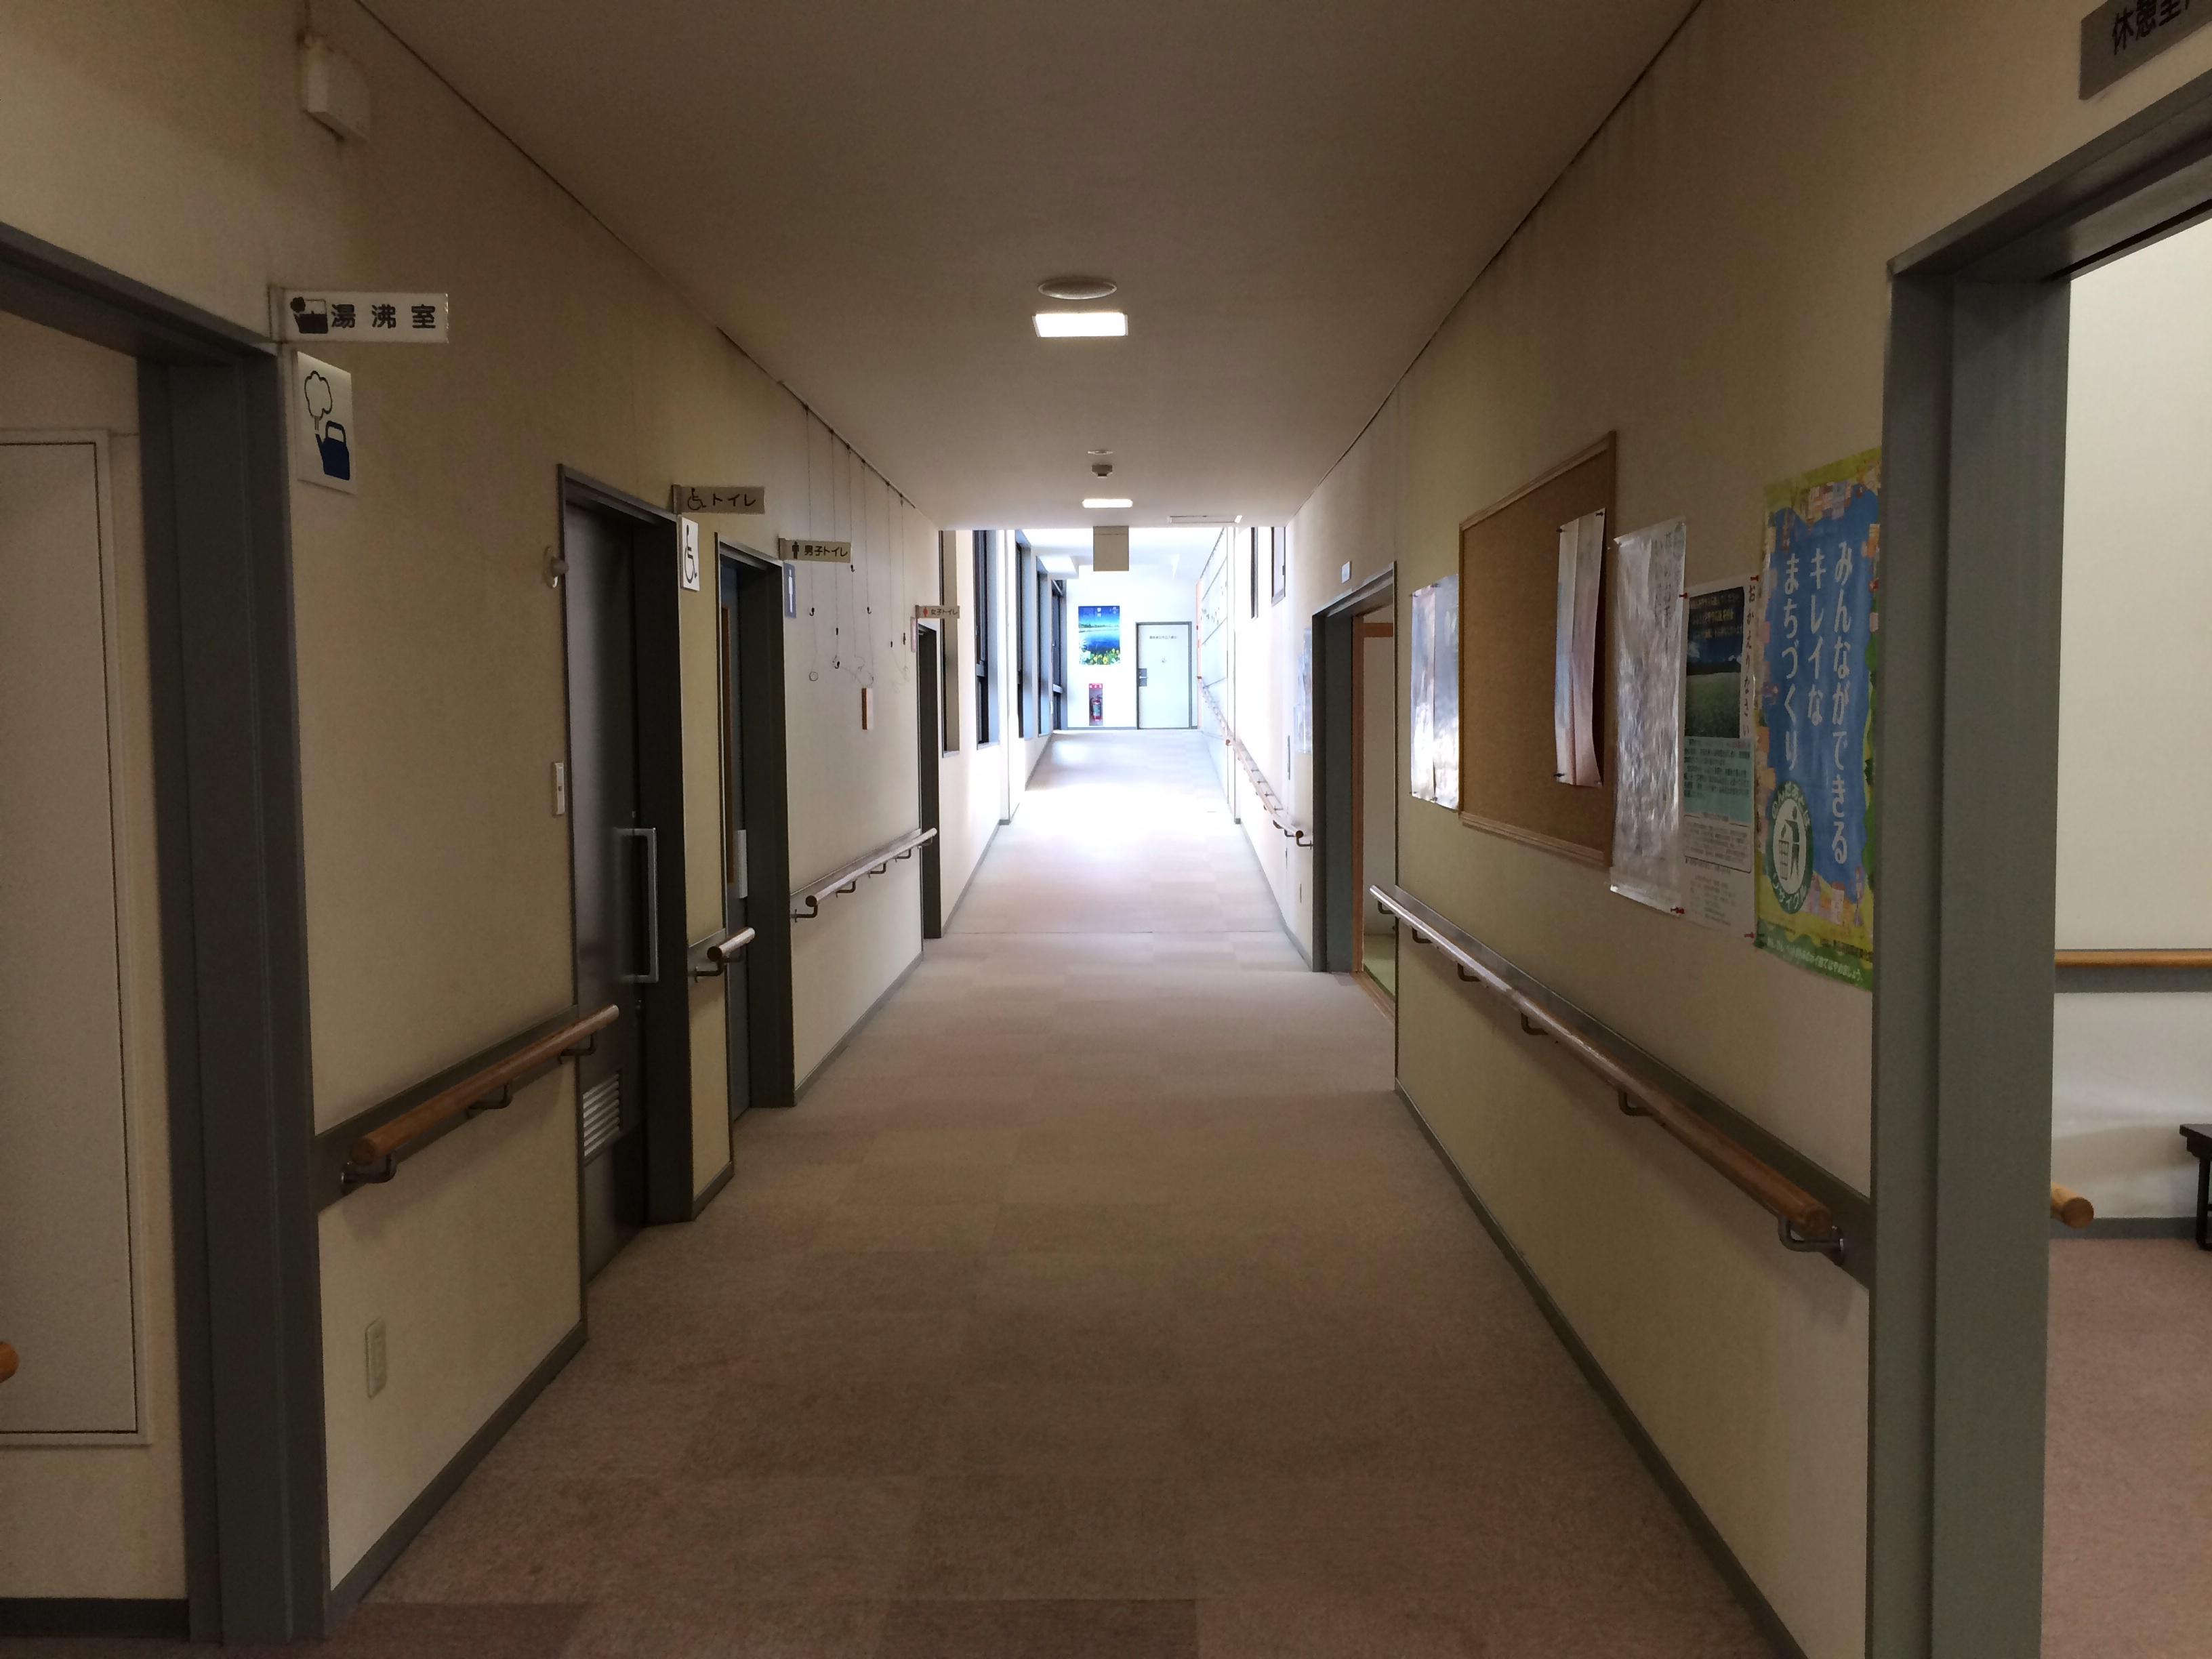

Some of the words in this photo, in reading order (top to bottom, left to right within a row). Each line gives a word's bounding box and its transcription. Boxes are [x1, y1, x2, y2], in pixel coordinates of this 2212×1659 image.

[331, 304, 436, 329] 湯沸室
[713, 493, 756, 506] トイレ
[804, 545, 848, 557] 男子トイレ
[1782, 553, 1799, 771] まちづくり
[1808, 548, 1827, 726] キレイな
[1832, 541, 1853, 864] みんなができる
